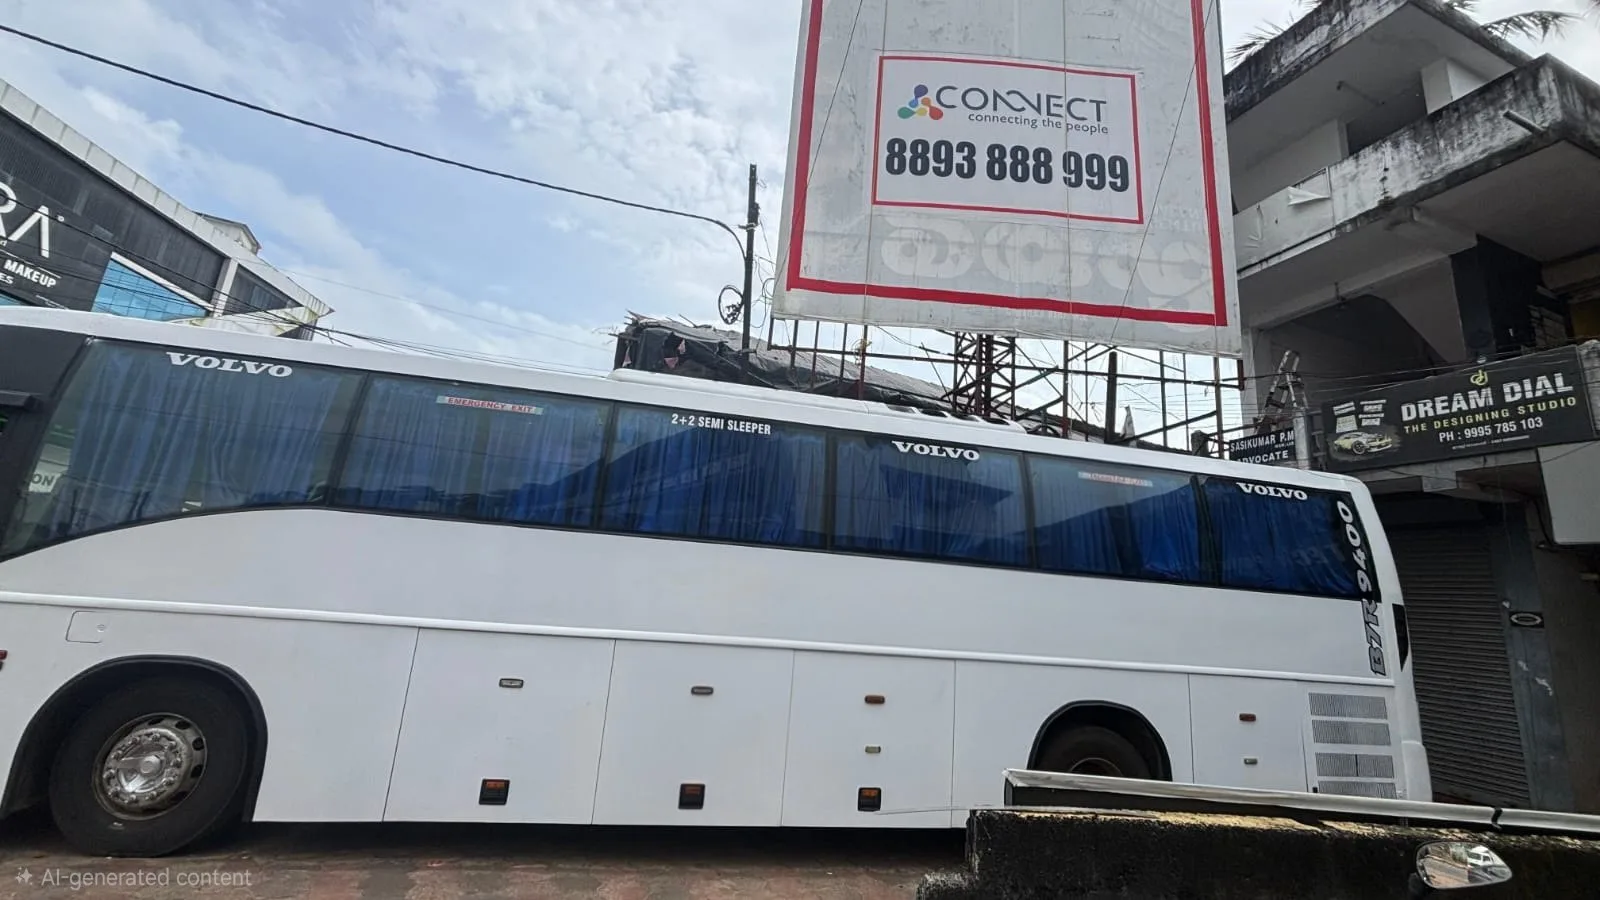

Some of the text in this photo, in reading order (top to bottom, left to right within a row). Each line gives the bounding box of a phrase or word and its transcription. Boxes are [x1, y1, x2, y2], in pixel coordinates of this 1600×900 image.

[936, 85, 1107, 122] CONNECT
[968, 113, 1109, 136] connecting the people
[885, 137, 1130, 193] 8893 888 999
[4, 259, 57, 288] MAKEUP
[166, 352, 293, 378] VOLVO
[447, 397, 533, 413] EMERGENCY EXIT
[1401, 387, 1494, 421] DREAM
[1502, 372, 1573, 403] DIAL
[671, 413, 771, 435] 2+2 SEMI SLEEPER
[1404, 396, 1577, 434] THE DESIGNING STUDIO
[1464, 425, 1492, 439] 9995
[1495, 421, 1517, 434] 785
[1520, 417, 1544, 430] 103
[891, 440, 981, 461] VOLVO
[1230, 434, 1276, 452] SASIKUMAR
[1236, 482, 1309, 500] VOLVO
[1337, 500, 1387, 676] B7R 9400
